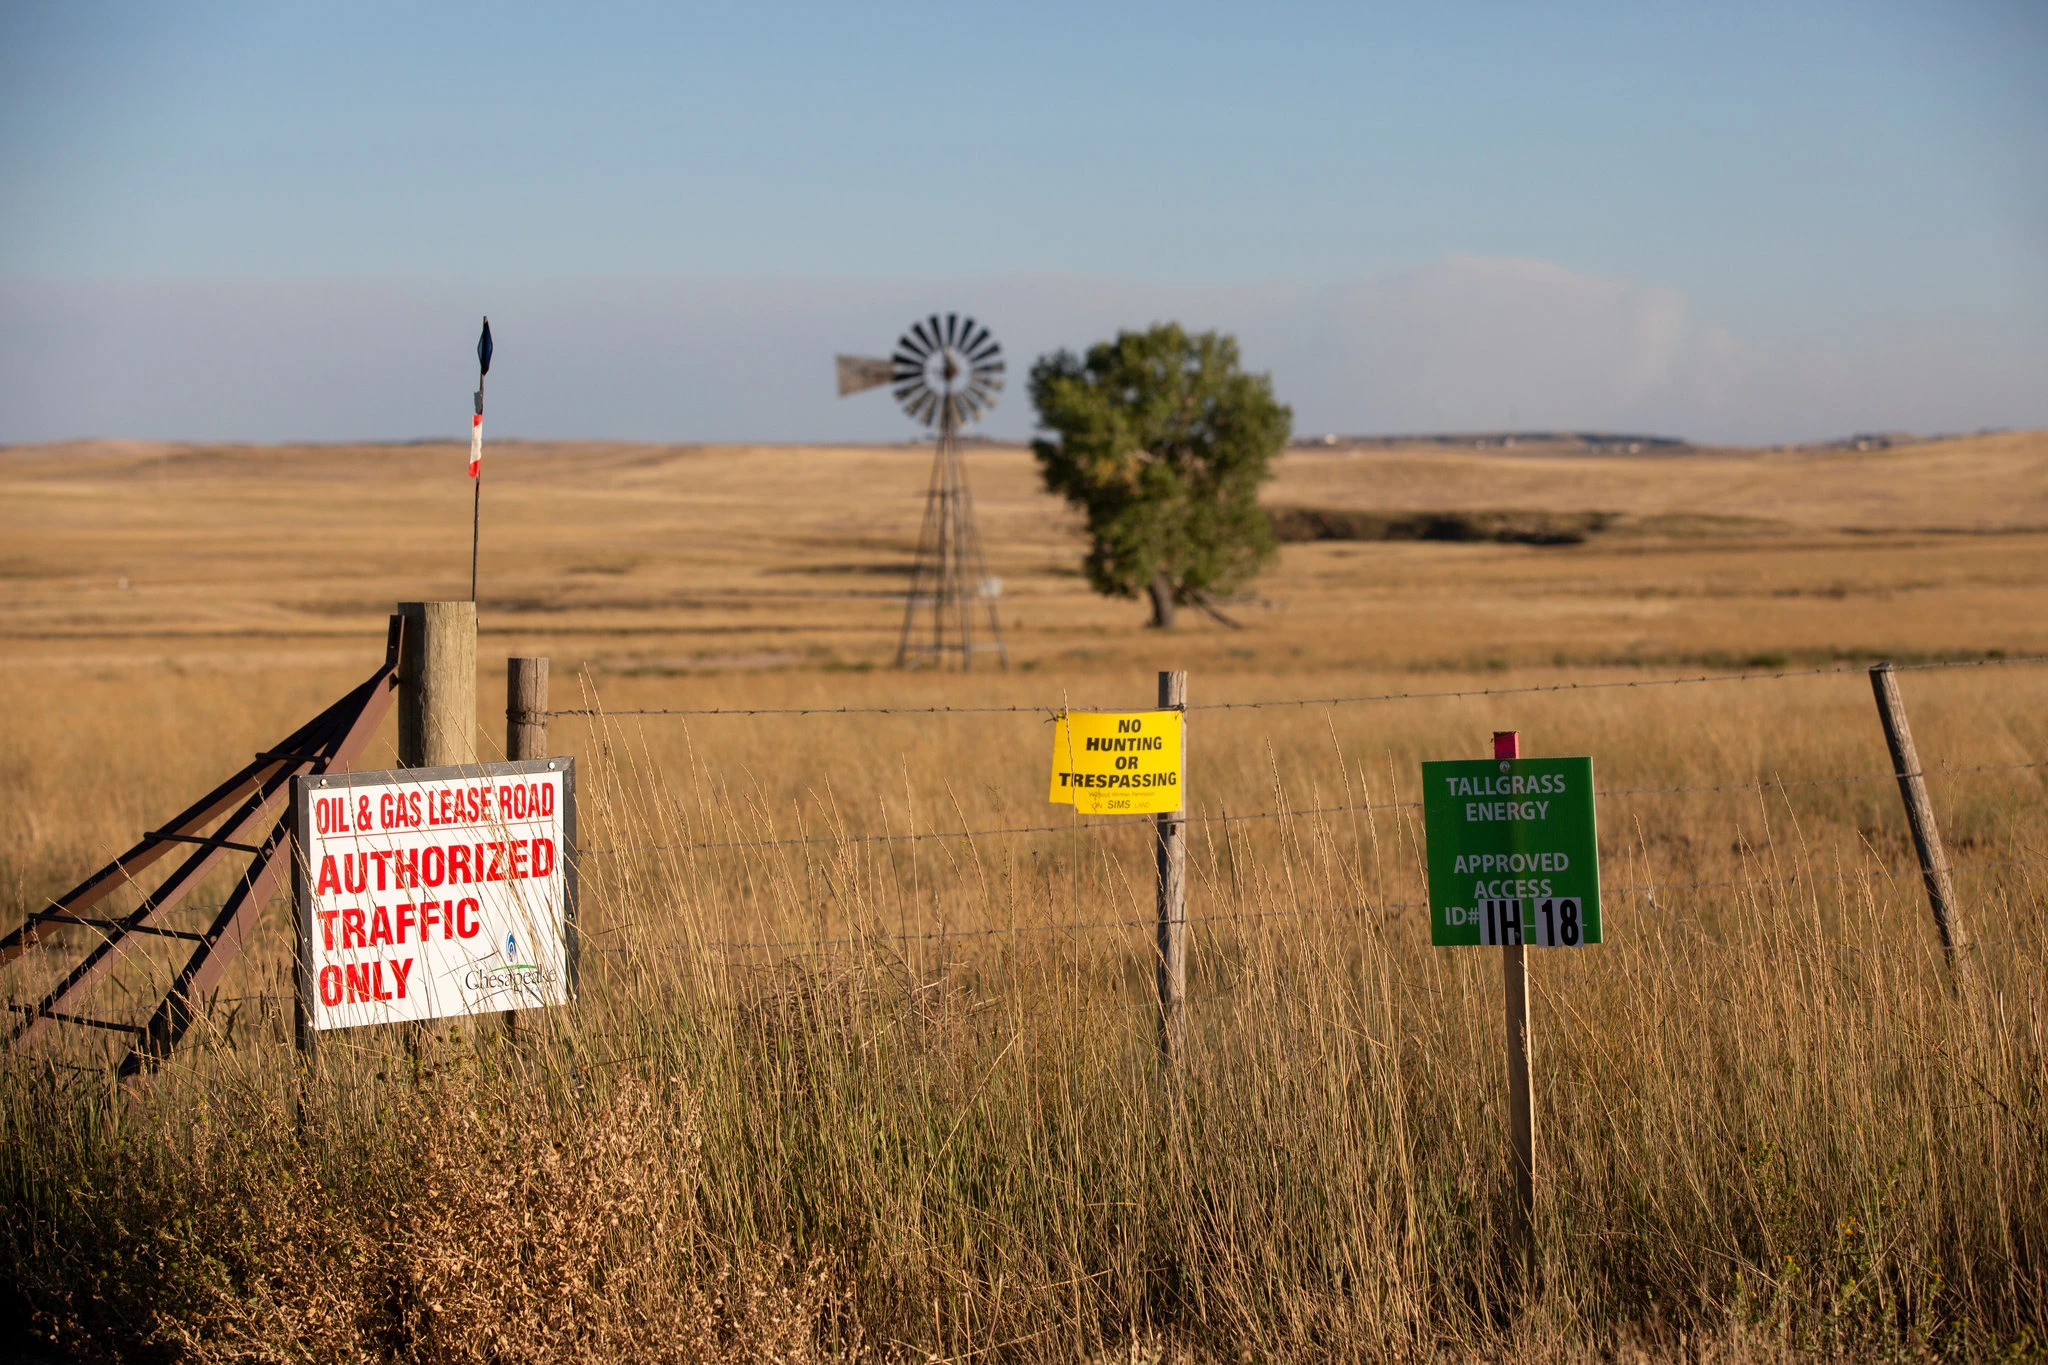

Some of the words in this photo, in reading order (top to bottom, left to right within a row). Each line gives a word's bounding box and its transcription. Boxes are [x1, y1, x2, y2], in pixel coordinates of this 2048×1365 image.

[1118, 719, 1141, 733] NO
[1086, 736, 1162, 751] HUNTING
[1115, 756, 1138, 770] OR
[1059, 772, 1176, 788] TRESPASSING
[1446, 774, 1566, 796] TALLGRASS
[316, 797, 349, 834] OIL
[357, 794, 373, 831] &
[380, 791, 421, 830] GAS
[428, 787, 492, 826] LEASE
[499, 782, 554, 820] ROAD
[1107, 800, 1131, 809] SIMS
[1466, 801, 1549, 821] ENERGY
[316, 838, 554, 896] AUTHORIZED
[1454, 852, 1569, 874] APPROVED
[1474, 879, 1553, 899] ACCESS
[317, 897, 480, 951] TRAFFIC
[1445, 906, 1480, 925] ID#
[1541, 899, 1579, 946] 18
[319, 958, 413, 1007] ONLY
